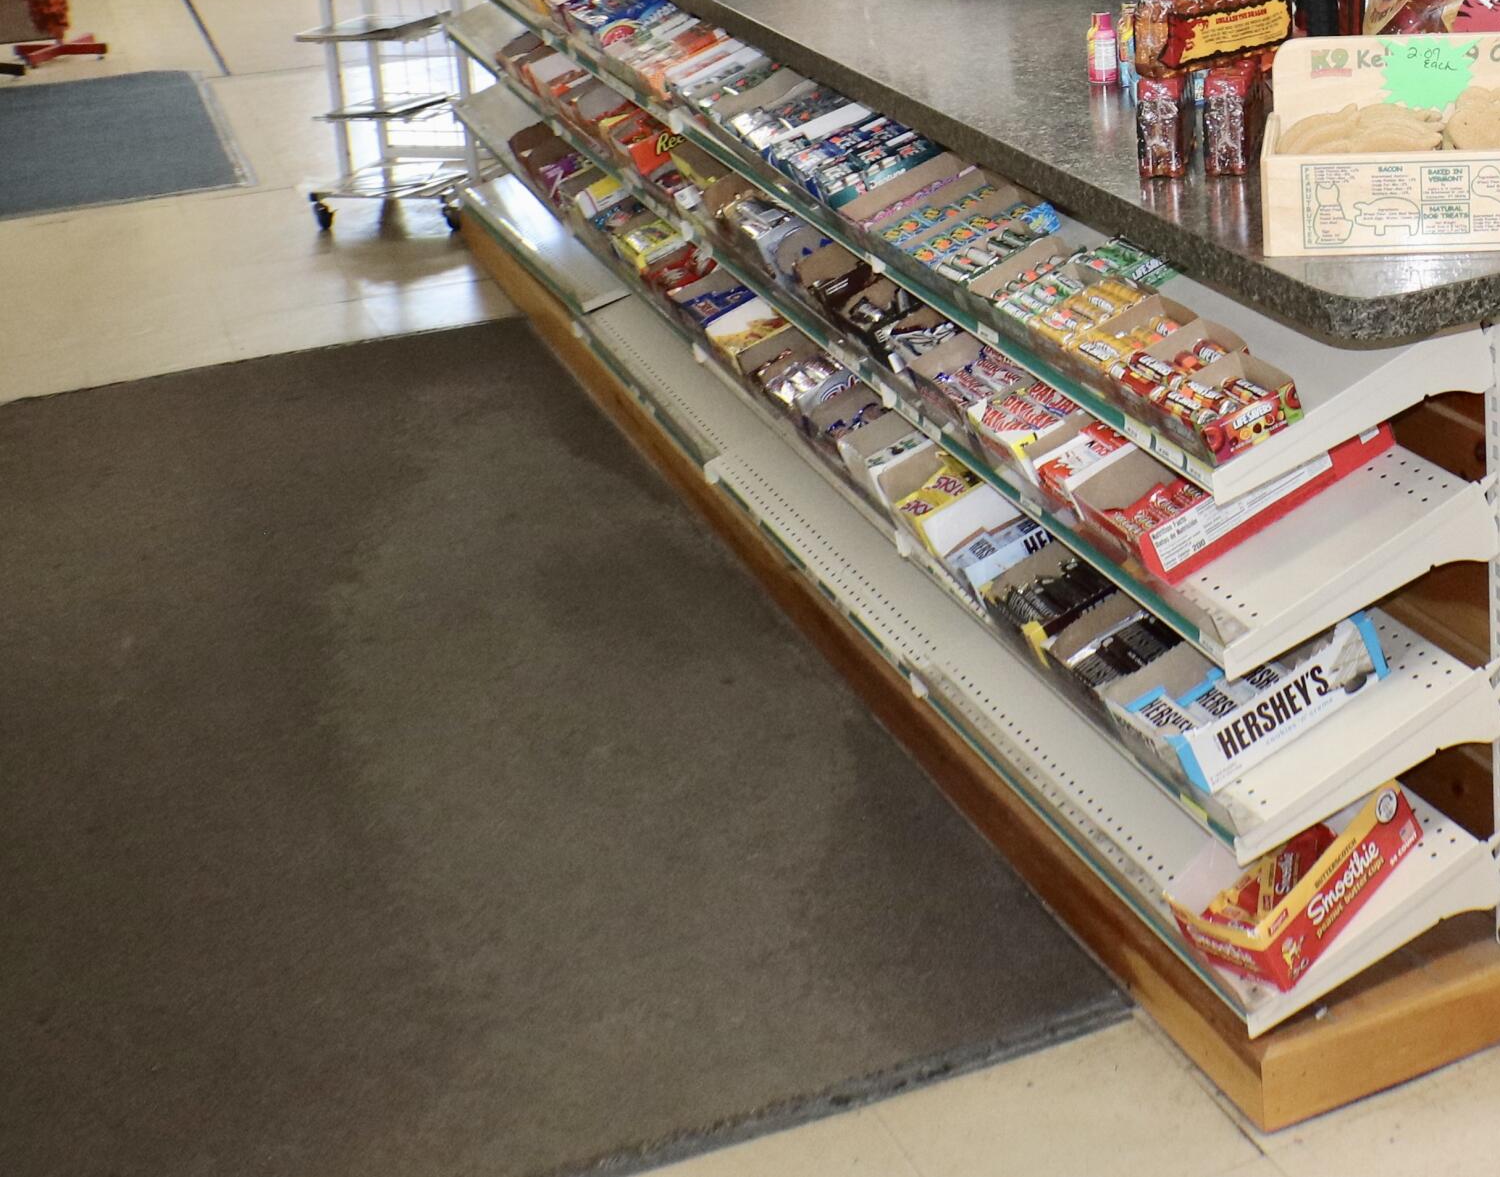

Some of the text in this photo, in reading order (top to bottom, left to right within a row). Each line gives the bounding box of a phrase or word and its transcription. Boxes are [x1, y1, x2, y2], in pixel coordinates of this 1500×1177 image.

[1310, 47, 1349, 71] K9
[1407, 46, 1440, 60] 2.09
[1423, 58, 1458, 71] Each
[1441, 212, 1469, 220] TREATS
[1233, 403, 1273, 430] LIFE SAVERS
[1216, 664, 1330, 760] HERSHEY'S
[1397, 831, 1417, 857] COUNT
[1314, 838, 1358, 889] BUTTERSCOTCH
[1307, 841, 1380, 925] Smoothie
[1316, 856, 1385, 939] peanut butter cups
